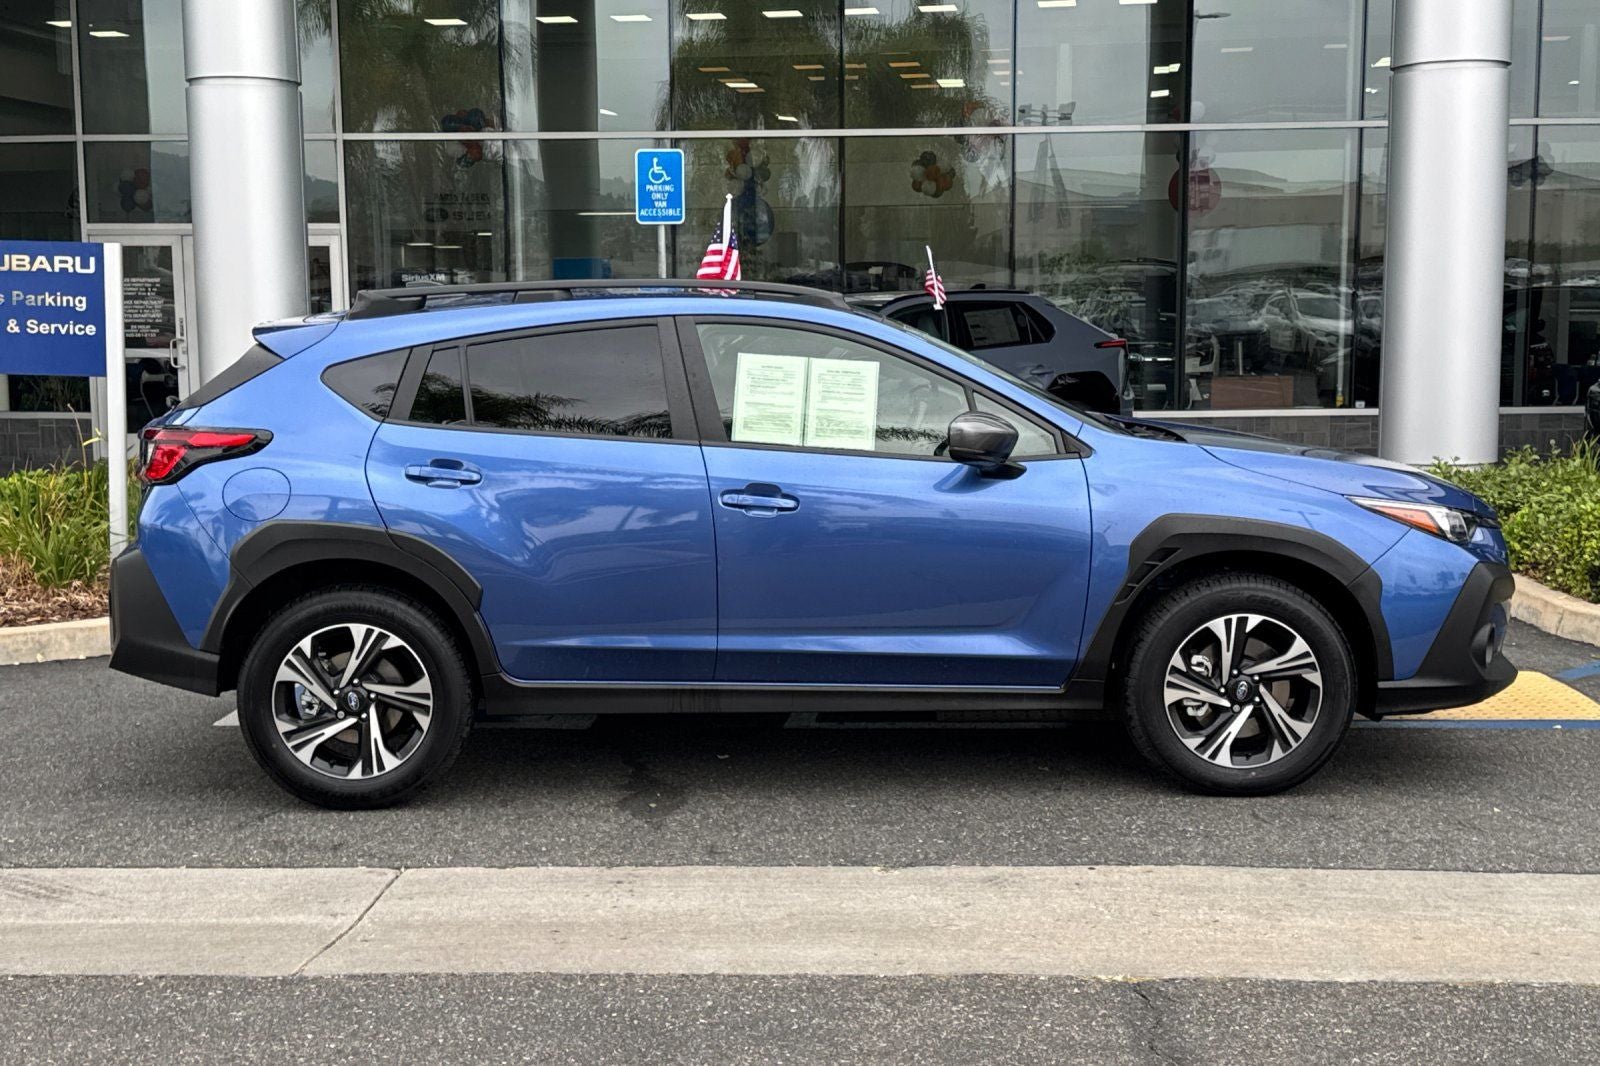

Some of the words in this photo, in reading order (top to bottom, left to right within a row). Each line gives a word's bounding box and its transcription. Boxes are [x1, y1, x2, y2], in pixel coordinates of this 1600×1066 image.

[645, 184, 675, 192] PARKING
[651, 192, 669, 200] ONLY
[640, 208, 681, 216] ACCESSIBLE
[401, 273, 446, 282] SiriusXM
[12, 290, 87, 311] Parking
[6, 318, 21, 334] &
[26, 318, 97, 336] Service
